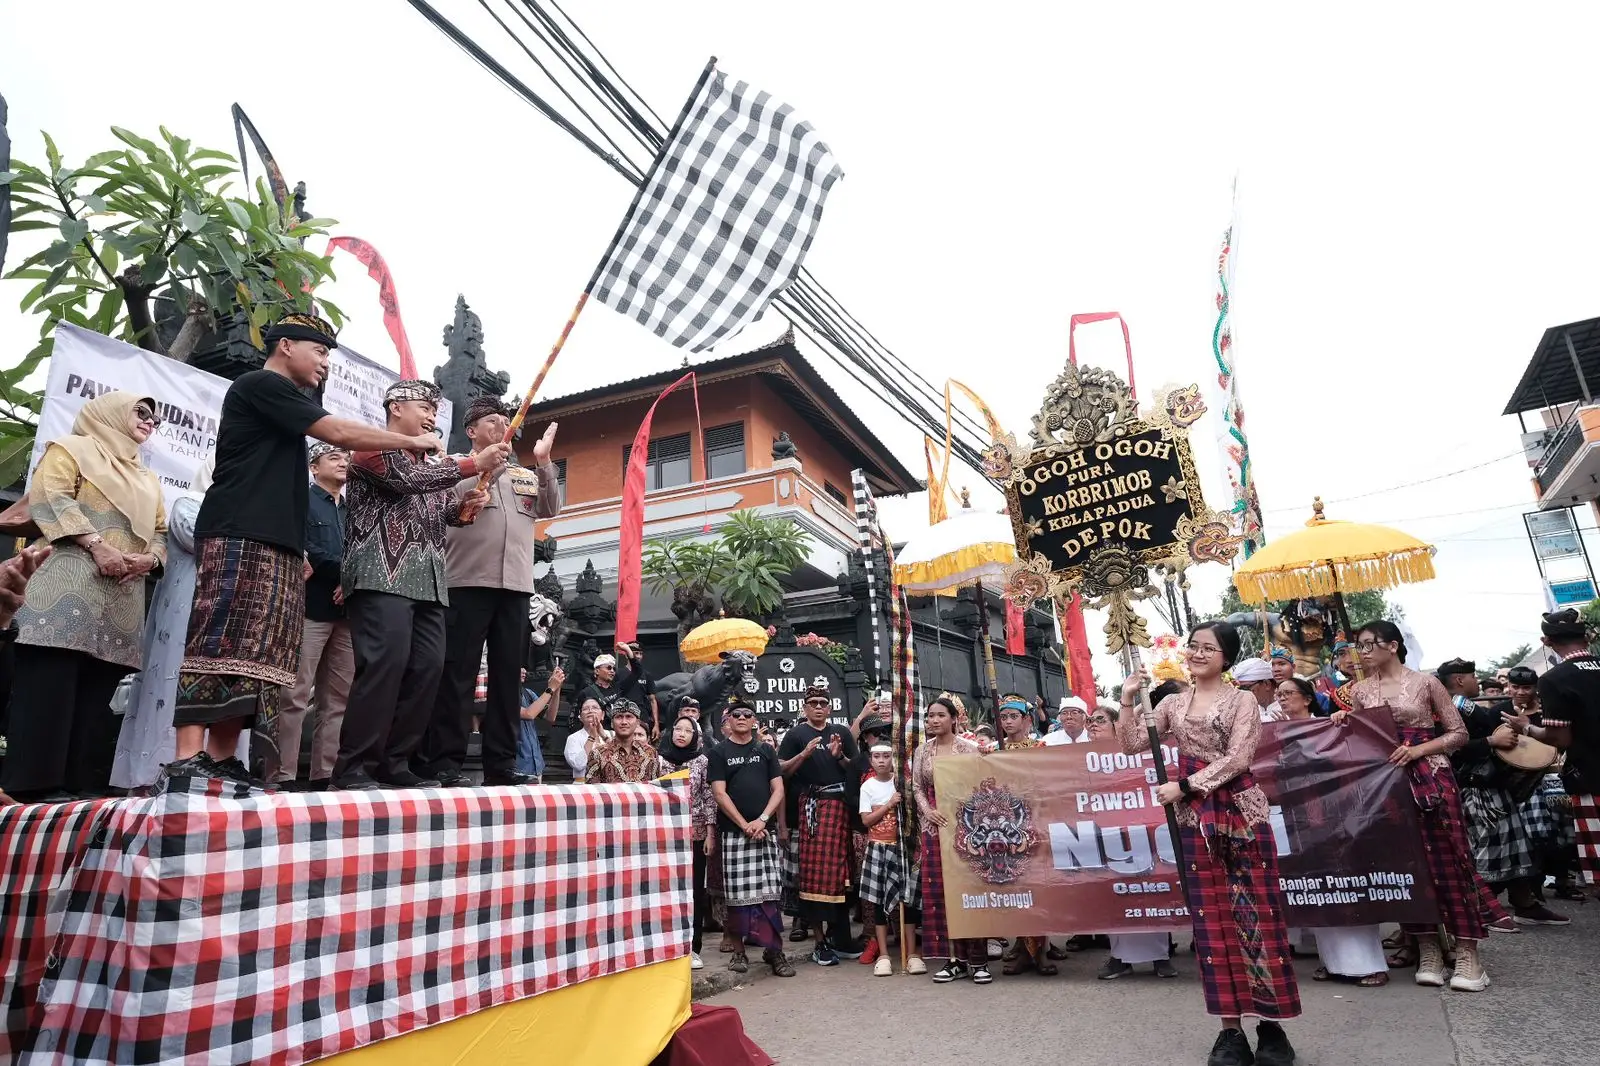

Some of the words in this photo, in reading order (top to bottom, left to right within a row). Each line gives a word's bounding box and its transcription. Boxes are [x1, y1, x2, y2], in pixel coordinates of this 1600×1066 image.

[66, 374, 120, 400] PAW
[156, 402, 218, 436] UDAYA
[156, 425, 202, 448] KAIAN
[168, 442, 208, 461] TAHU
[1020, 450, 1088, 496] OGOH
[1095, 439, 1174, 461] OGOH
[1066, 461, 1116, 487] PURA
[1042, 469, 1153, 516] KORBRIMOB
[1048, 493, 1156, 532] KELAPADUA
[1062, 518, 1153, 558] DEPOK
[767, 677, 807, 693] PURA
[755, 699, 783, 714] RPS
[727, 756, 745, 766] CAKA
[1076, 787, 1145, 813] Pawai
[1112, 881, 1171, 895] Caka
[1278, 876, 1323, 893] Banjar
[1326, 875, 1368, 889] Purna
[1369, 871, 1415, 887] Widya
[961, 892, 988, 910] Bawi
[990, 890, 1034, 909] Srenggi
[1368, 886, 1412, 902] Depok
[1125, 908, 1142, 919] 28
[1145, 906, 1191, 919] Maret
